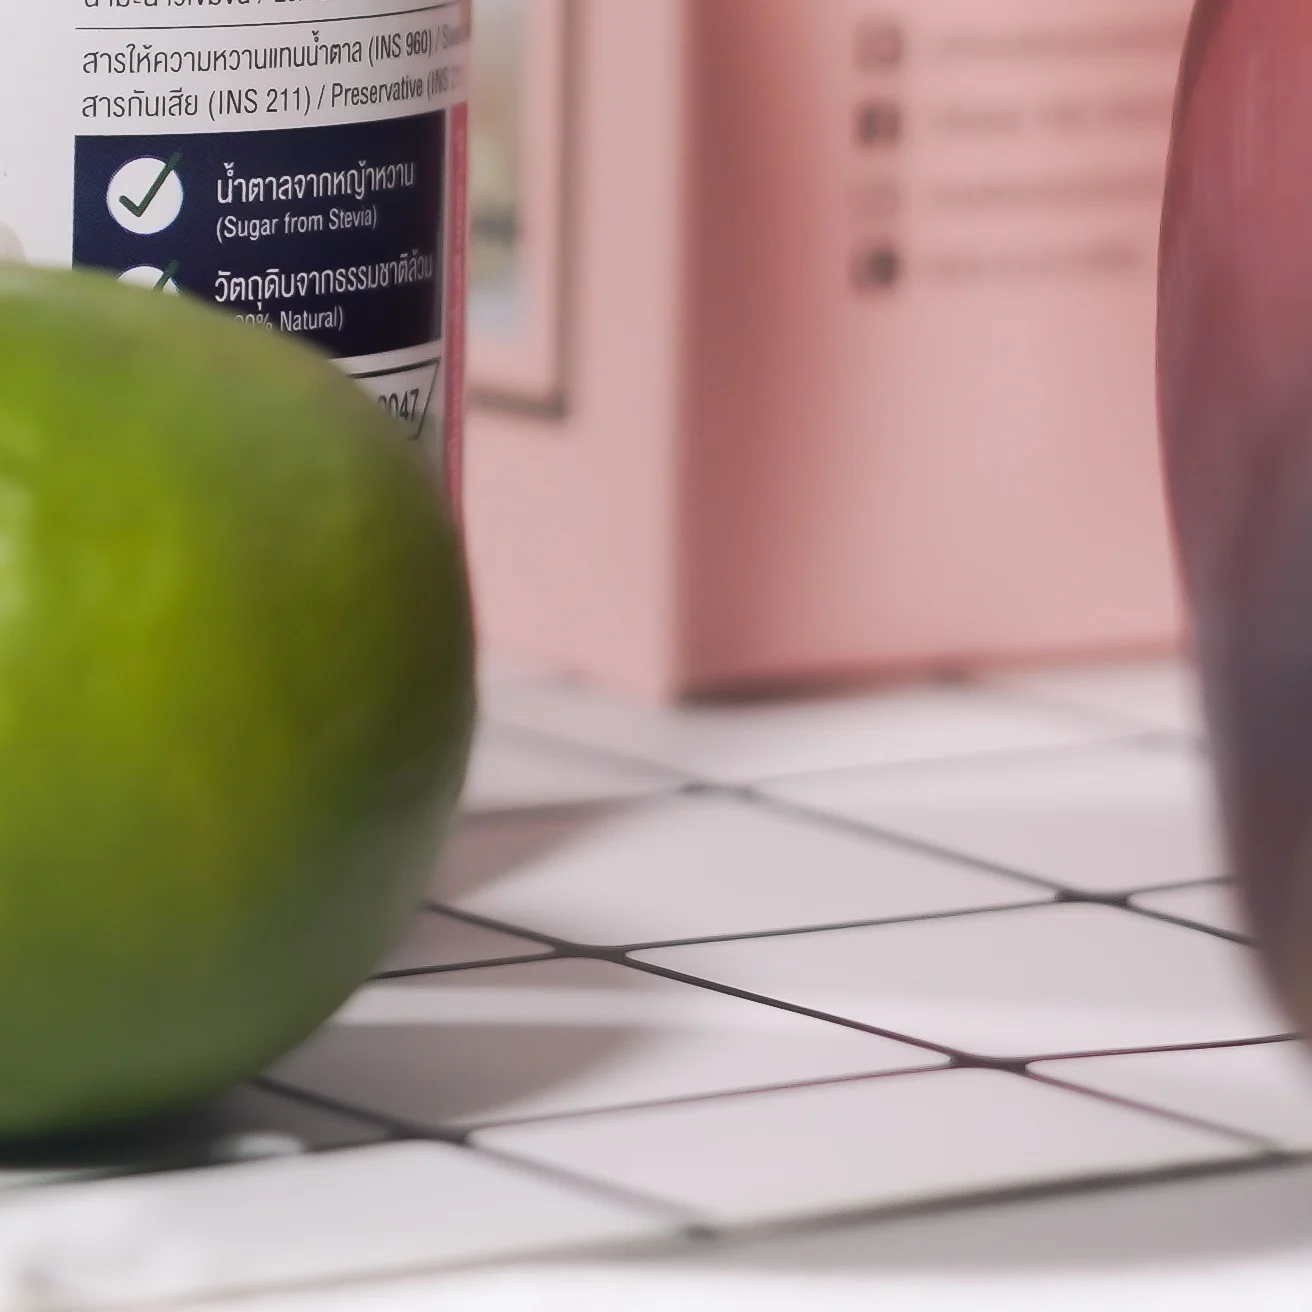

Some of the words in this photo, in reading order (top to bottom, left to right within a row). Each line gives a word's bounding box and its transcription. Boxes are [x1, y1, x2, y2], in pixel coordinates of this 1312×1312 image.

[82, 30, 363, 74] สารให้ความหวานแทนน้ำตาล
[369, 33, 401, 67] (INS
[406, 29, 432, 58] 960)
[81, 88, 199, 119] สารกันเสีย
[208, 88, 258, 121] (INS
[266, 86, 311, 116] 211)
[331, 75, 424, 109] Preservative
[216, 159, 415, 204] น้ำตาลจากหญ้าหวาน
[216, 216, 278, 244] (Sugar
[284, 211, 323, 237] from
[329, 204, 377, 232] Stevia)
[215, 248, 433, 310] วัตถุดิบจากธรรมชาติล้วน
[280, 306, 344, 332] Natural)
